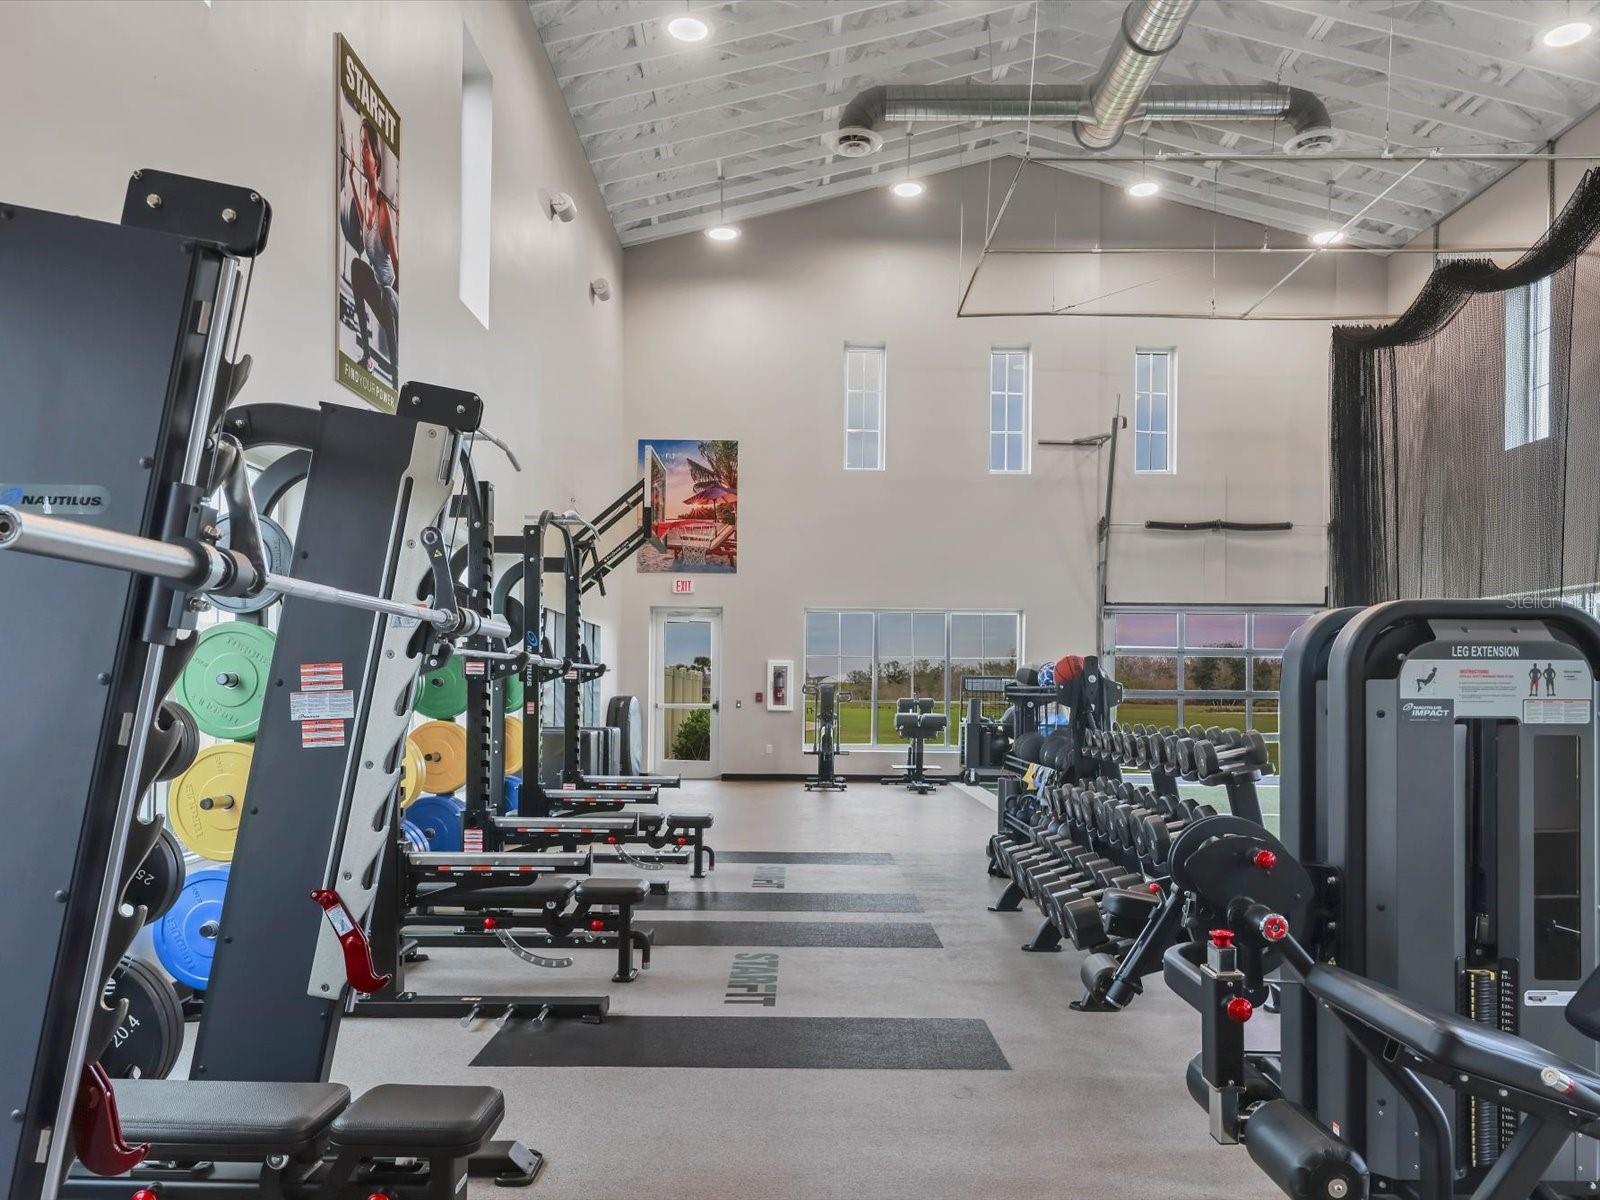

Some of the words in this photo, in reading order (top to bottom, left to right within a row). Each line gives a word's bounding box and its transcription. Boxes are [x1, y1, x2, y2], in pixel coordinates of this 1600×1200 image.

[346, 55, 396, 144] STARFIT
[21, 495, 102, 506] NAUTILUS
[676, 580, 692, 593] EXIT
[1451, 646, 1469, 657] LEG
[1471, 645, 1520, 657] EXTENSION
[135, 869, 155, 886] 25
[724, 953, 780, 1007] STARFIT
[114, 1014, 140, 1048] 20.4
